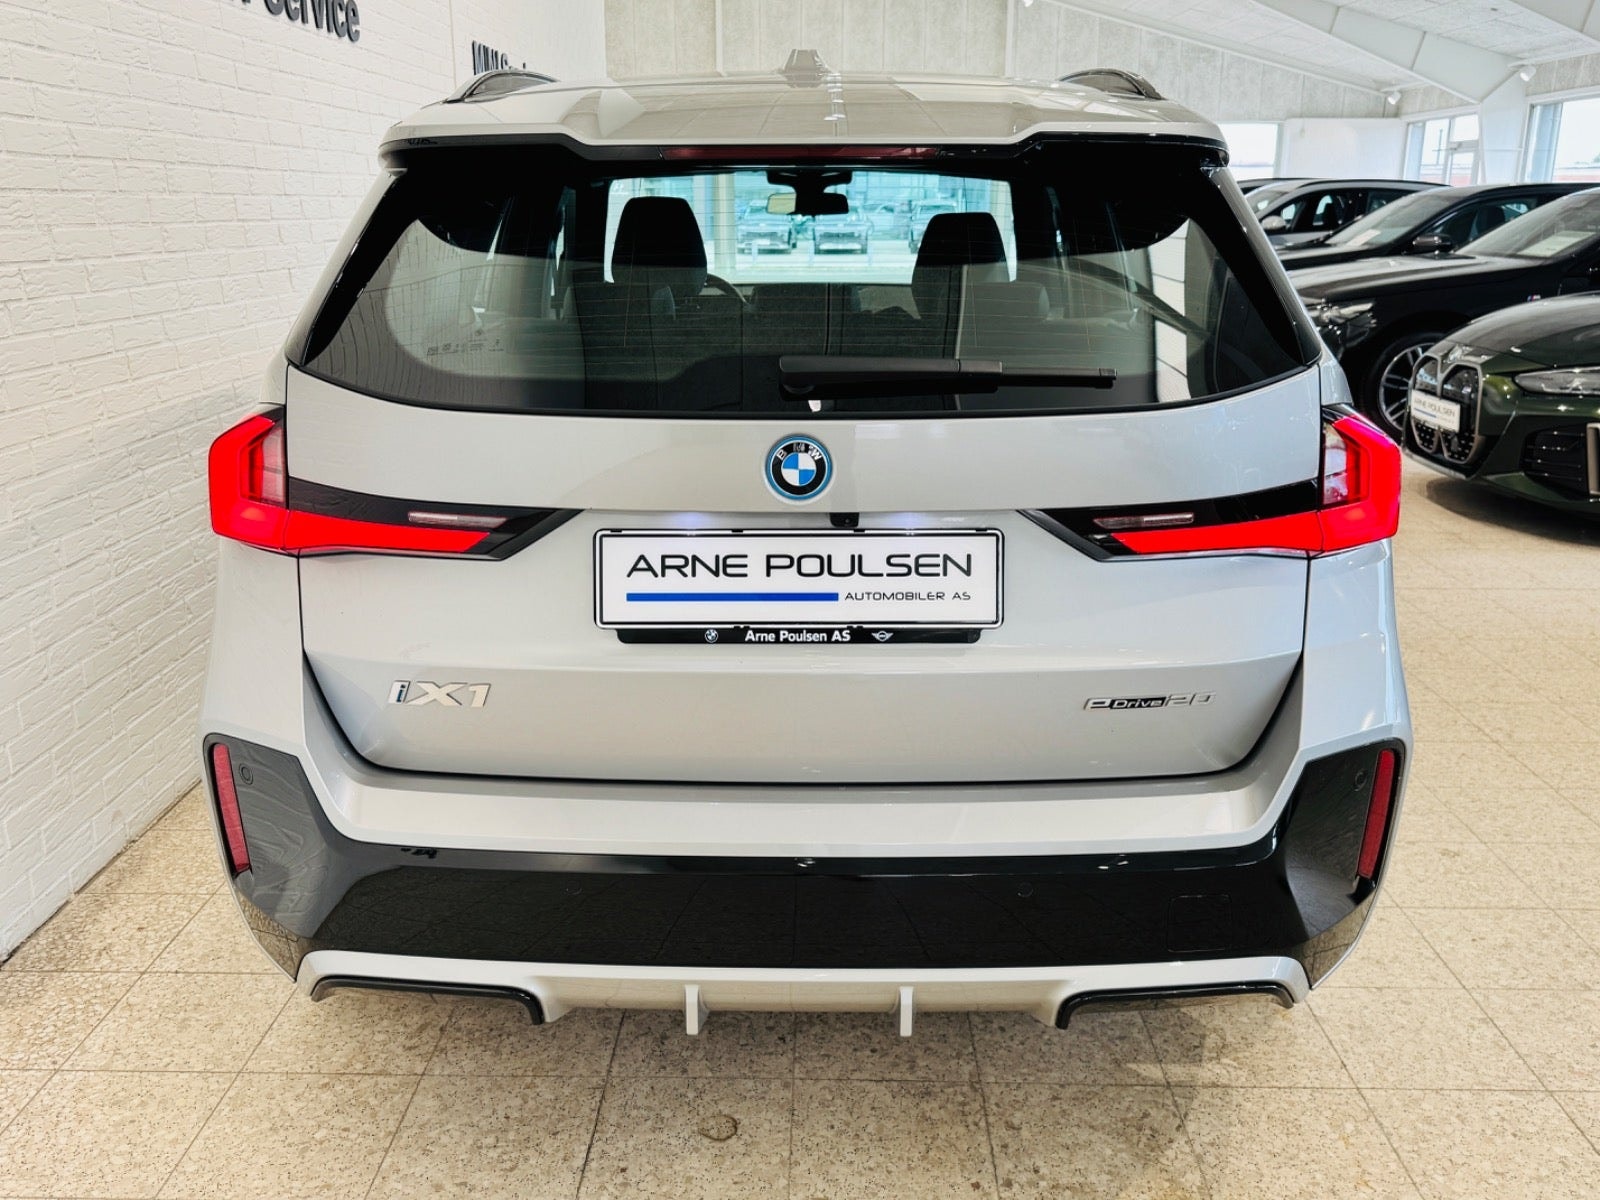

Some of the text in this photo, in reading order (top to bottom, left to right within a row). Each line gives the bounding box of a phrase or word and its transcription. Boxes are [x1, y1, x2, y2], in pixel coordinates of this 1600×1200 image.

[776, 442, 822, 460] BMW
[627, 554, 972, 578] ARNE POULSEN
[845, 591, 971, 601] AUTOMOBILER AS
[745, 629, 851, 642] Arne Poulsen AS
[388, 680, 491, 707] iX1
